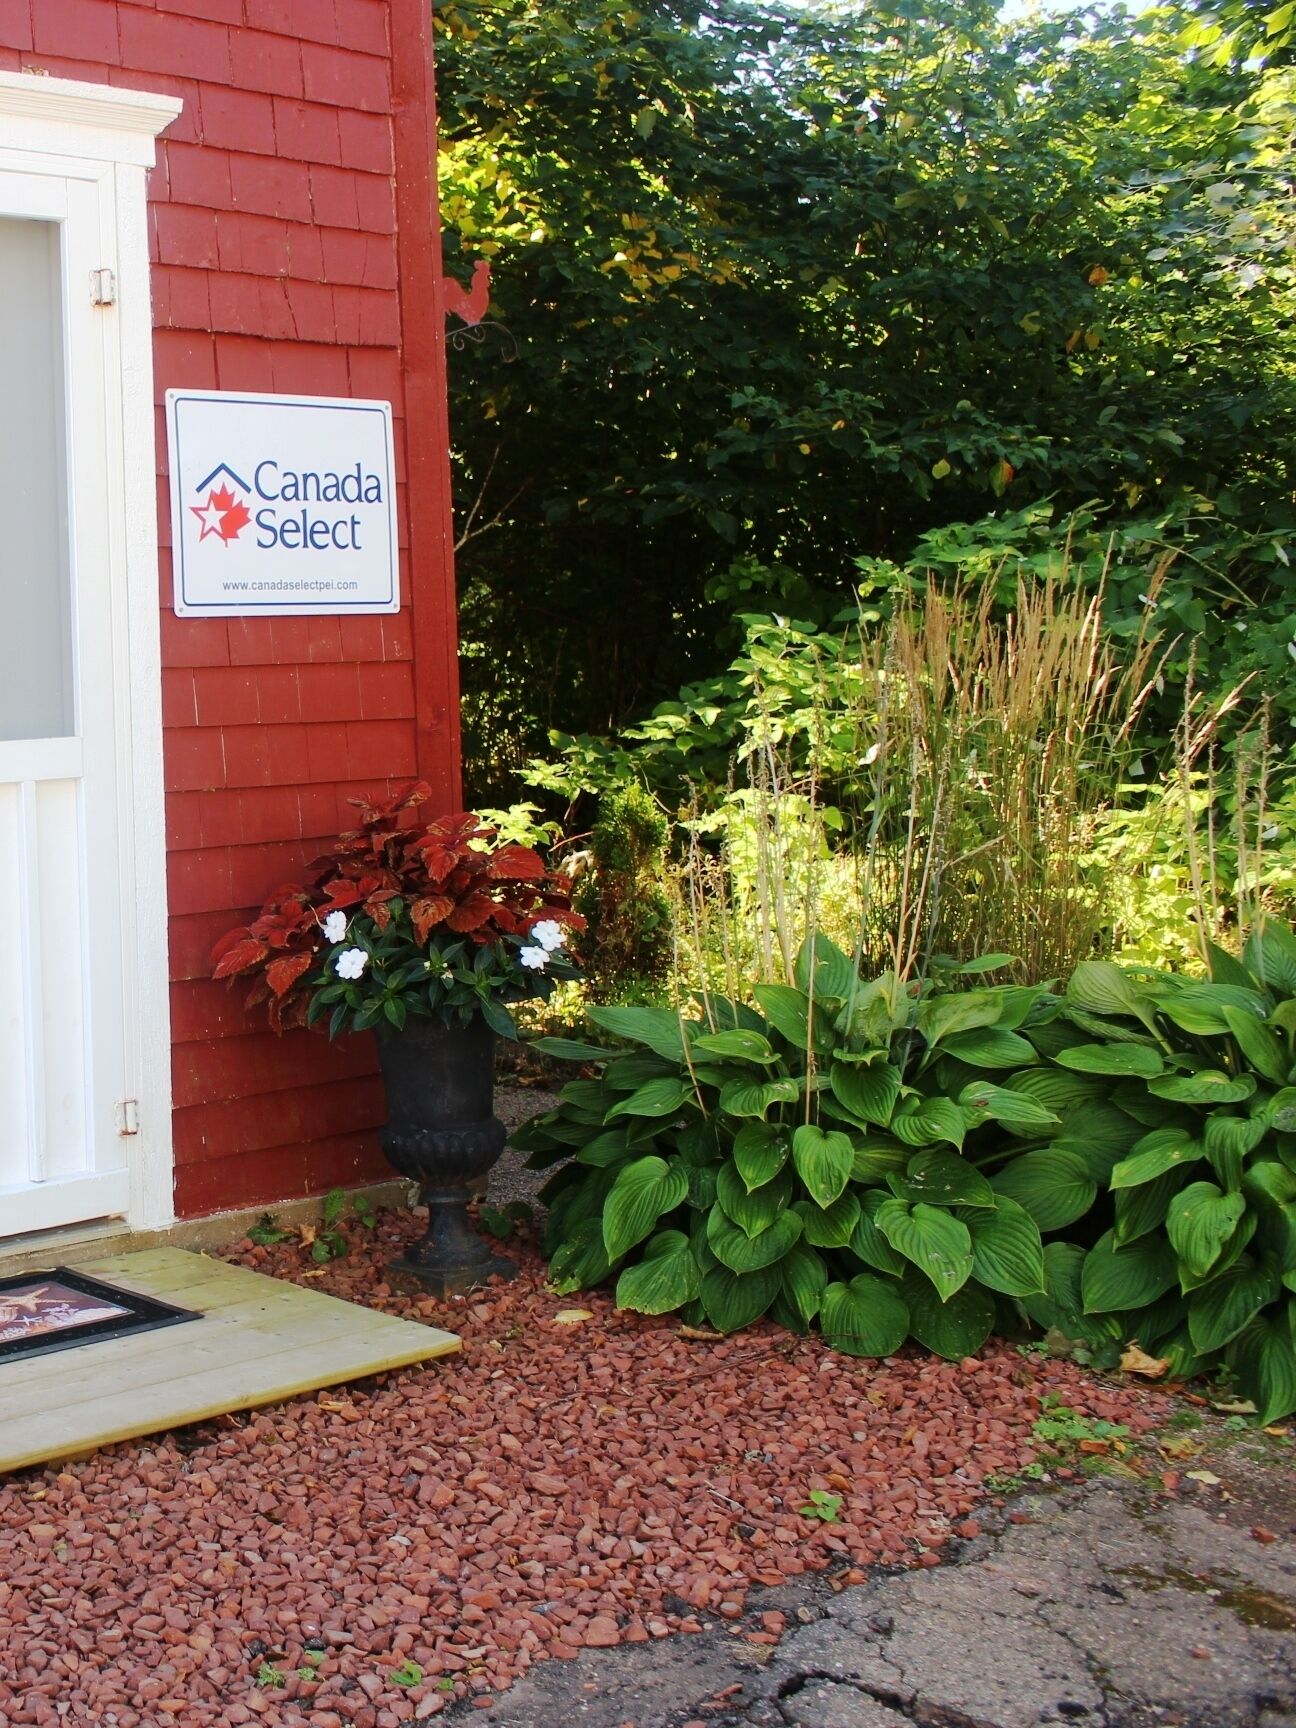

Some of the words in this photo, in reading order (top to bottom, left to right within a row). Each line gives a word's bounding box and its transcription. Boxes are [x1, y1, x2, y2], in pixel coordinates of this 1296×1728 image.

[254, 460, 382, 503] Canada
[255, 508, 362, 549] Select
[222, 579, 358, 593] www.canadaselectpei.com
